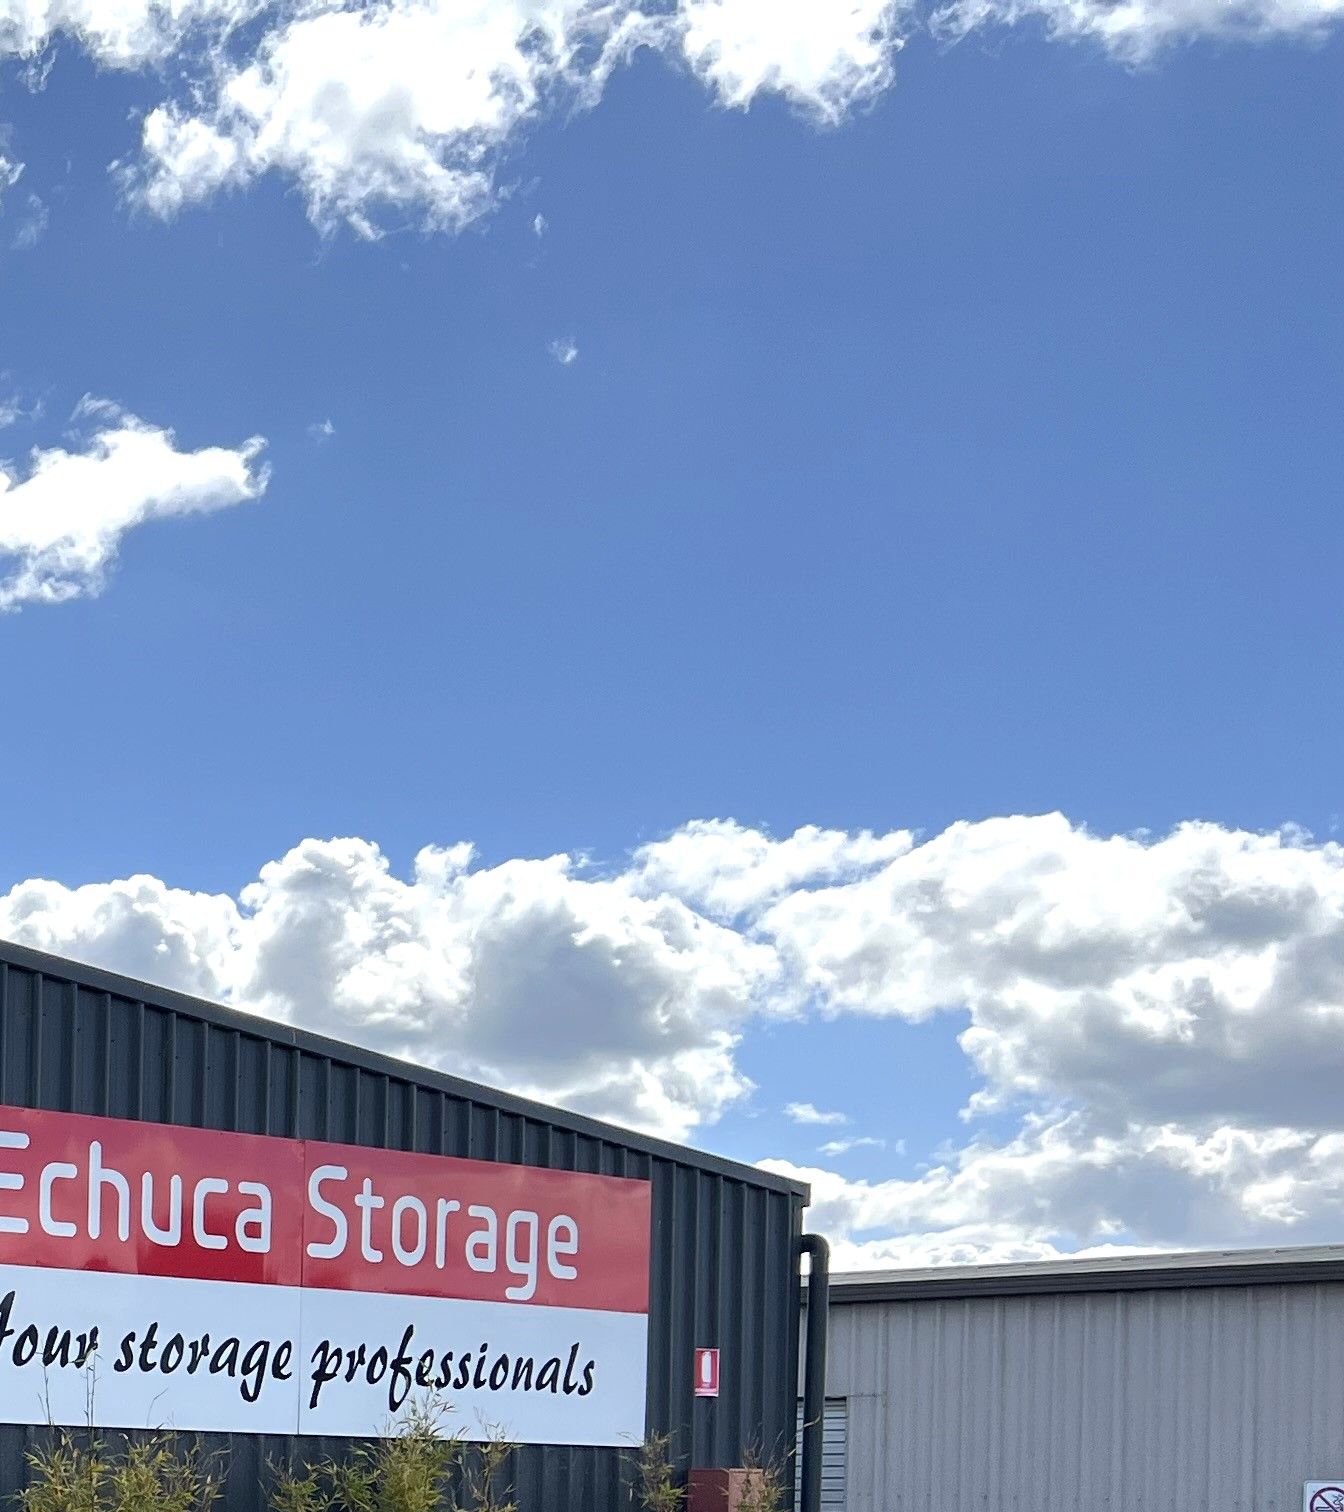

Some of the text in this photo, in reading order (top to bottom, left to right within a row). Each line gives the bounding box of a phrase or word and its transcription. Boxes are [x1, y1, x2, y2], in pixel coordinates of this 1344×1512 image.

[306, 1164, 579, 1301] Storage
[112, 1321, 293, 1403] storage
[309, 1323, 596, 1413] professionals
